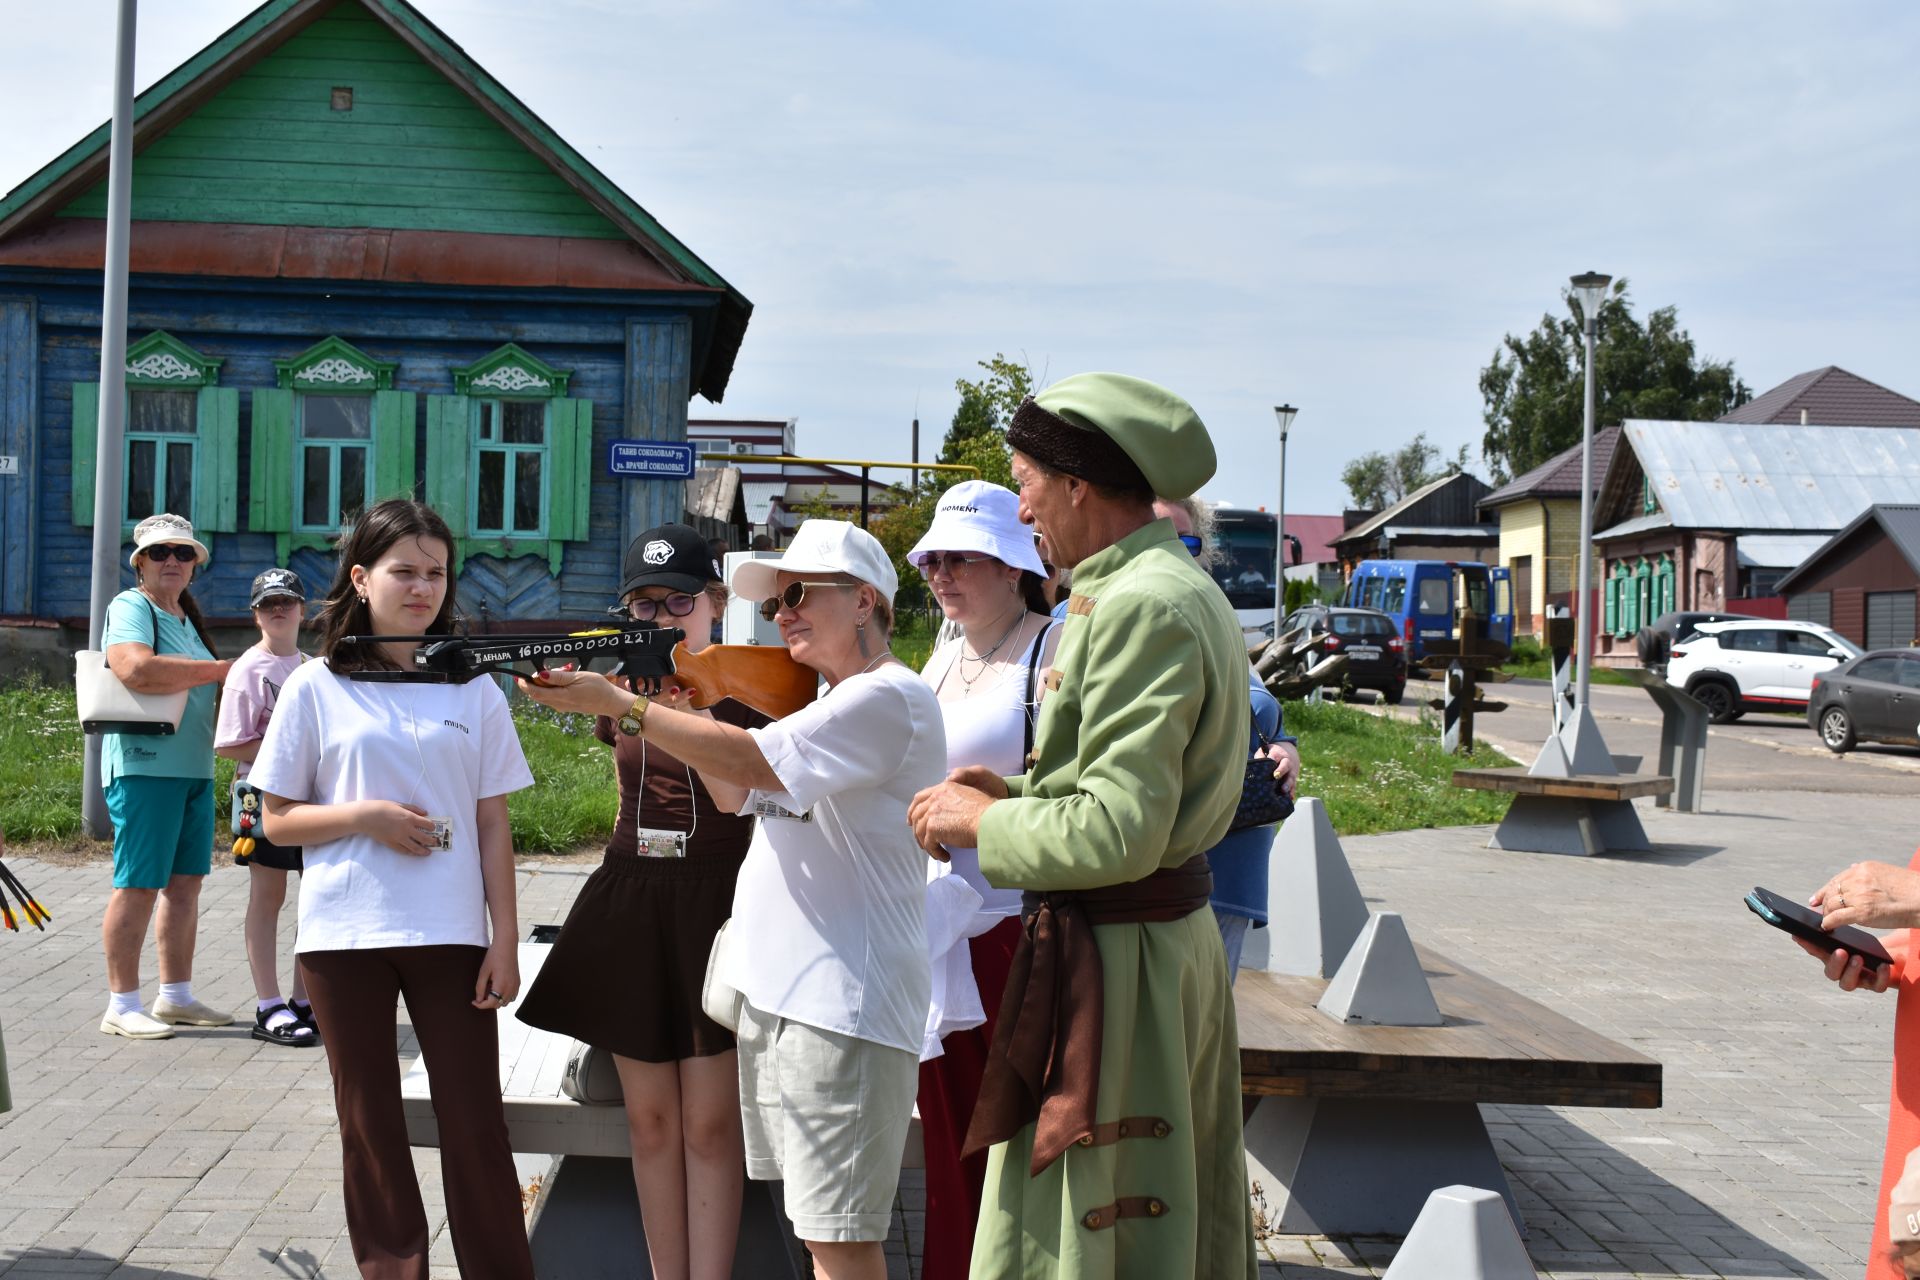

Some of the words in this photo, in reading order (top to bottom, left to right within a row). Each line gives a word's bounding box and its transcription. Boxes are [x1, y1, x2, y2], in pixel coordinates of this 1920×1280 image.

[638, 448, 675, 458] СОКОЛОВЛАР
[625, 460, 648, 470] ВРАЧЕЙ
[648, 462, 685, 472] СОКОЛОВЫХ
[941, 505, 979, 514] MOMENT
[482, 652, 512, 662] ДЕНДРА
